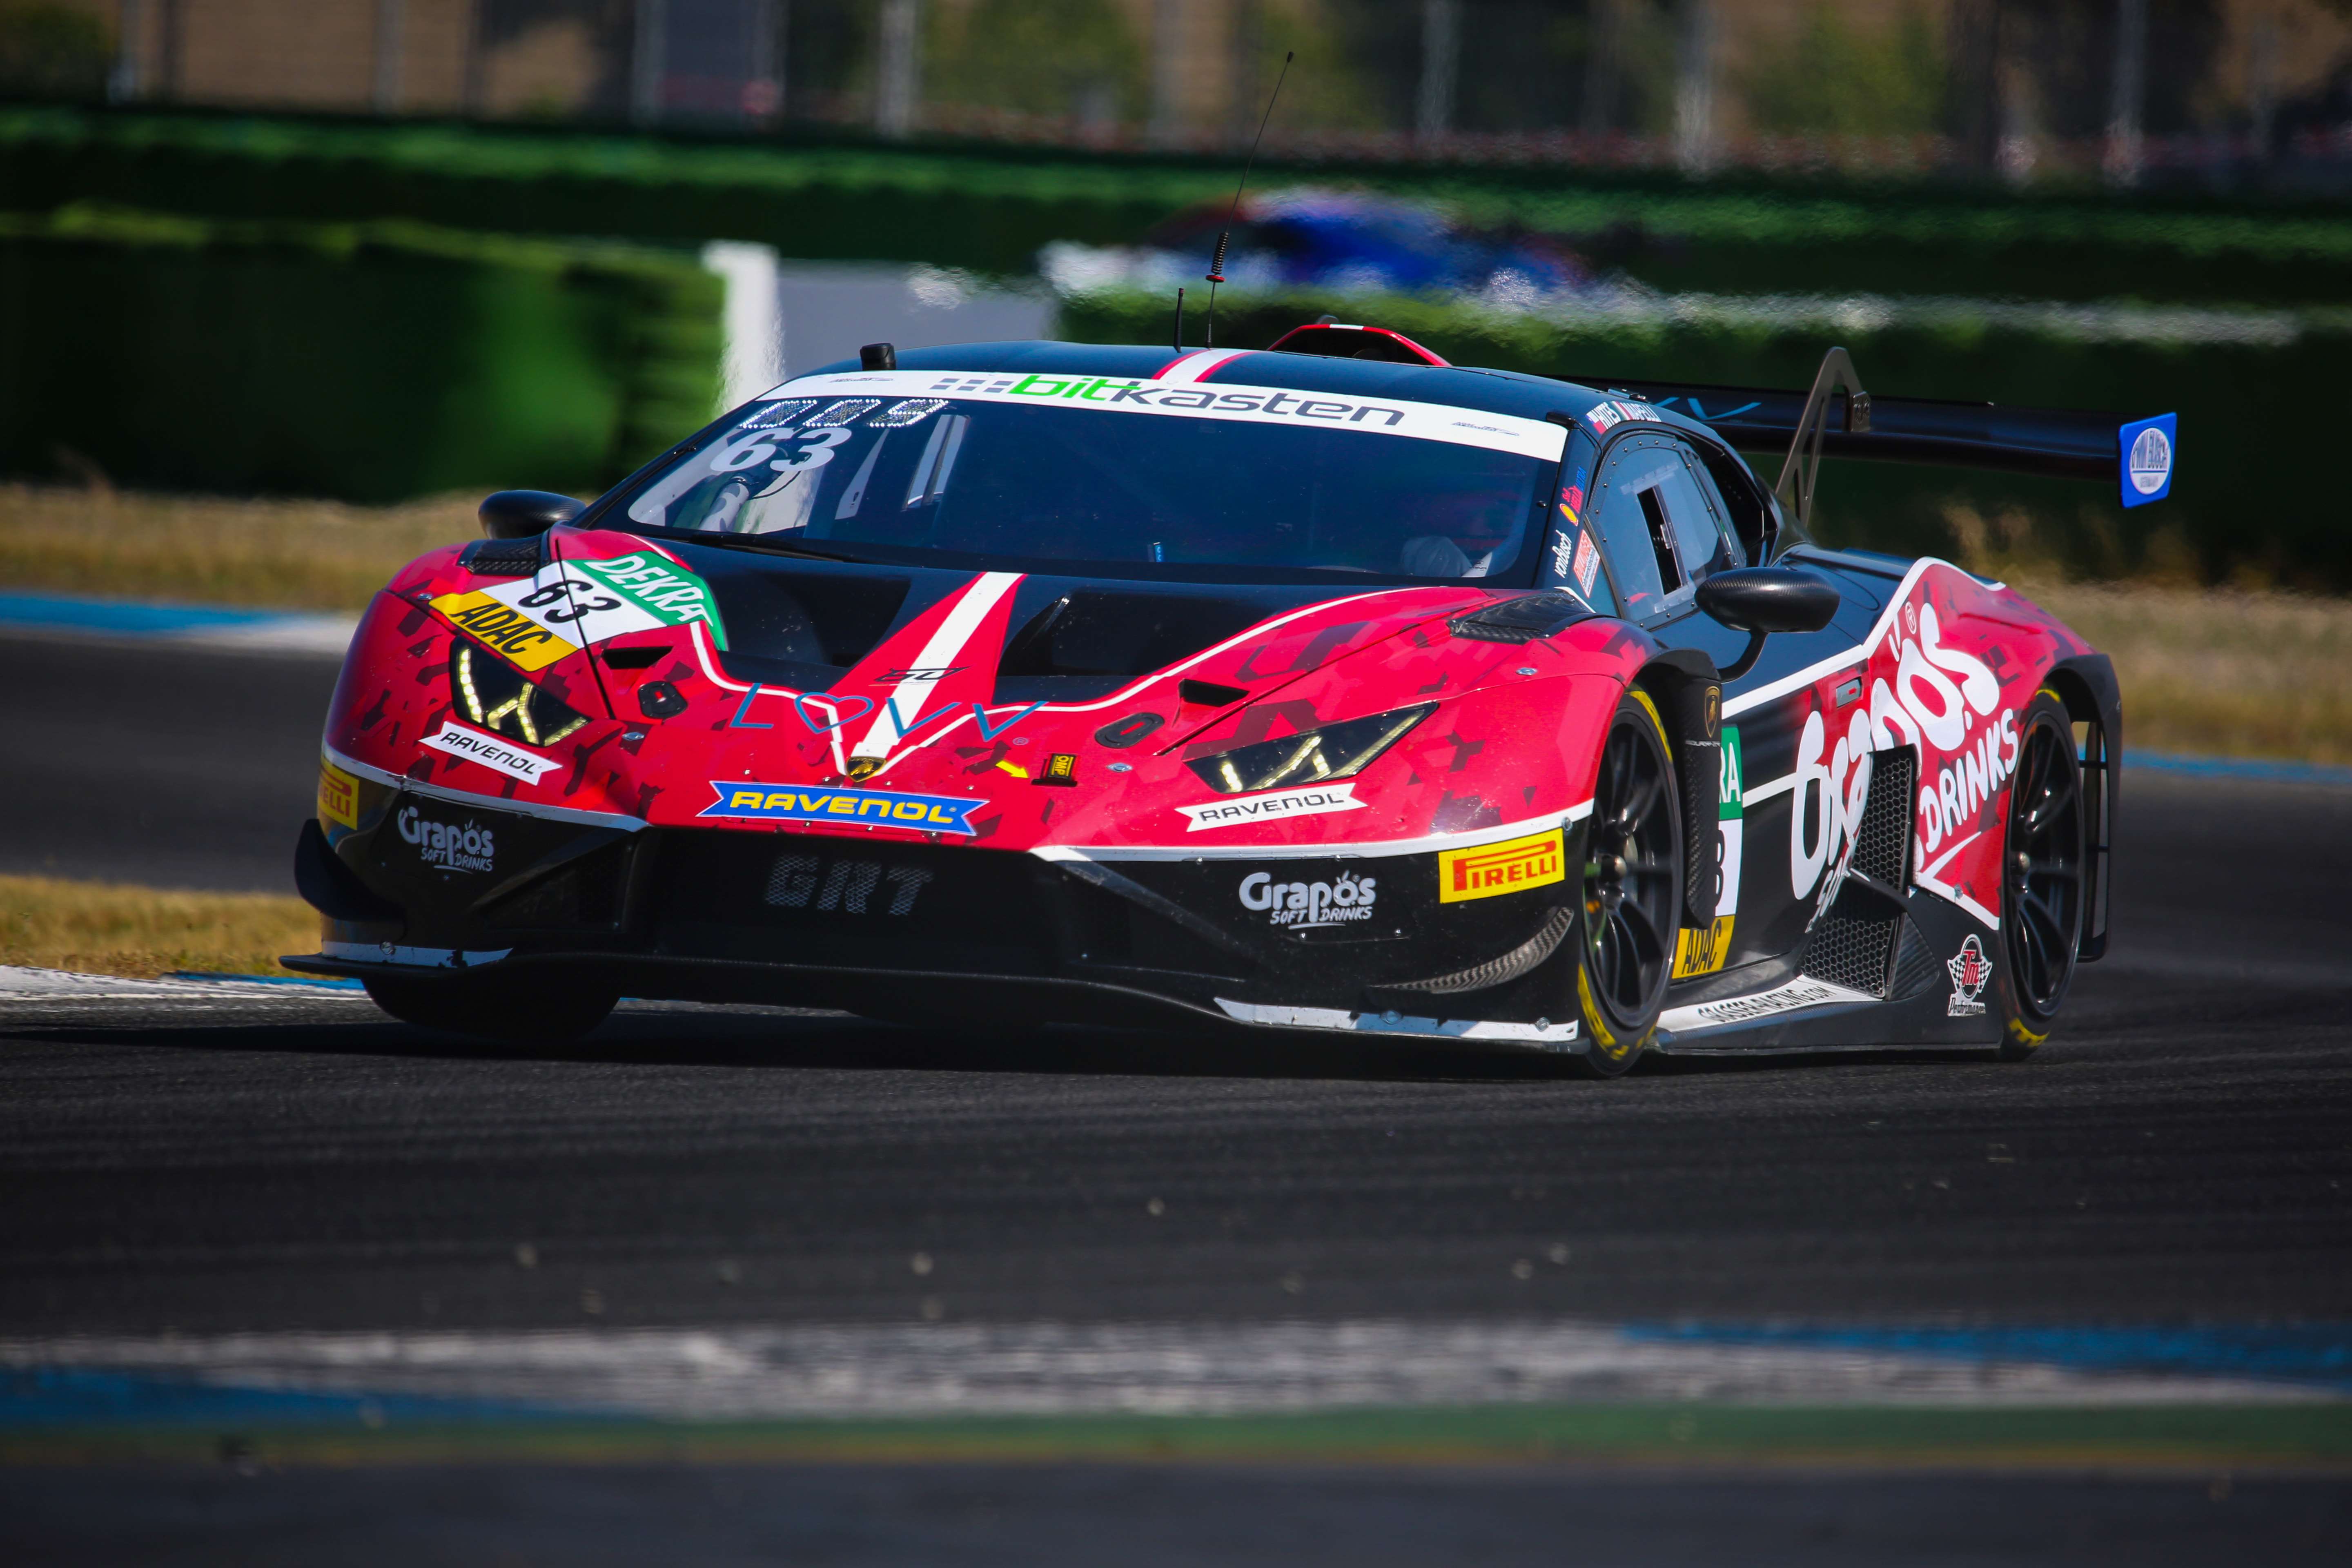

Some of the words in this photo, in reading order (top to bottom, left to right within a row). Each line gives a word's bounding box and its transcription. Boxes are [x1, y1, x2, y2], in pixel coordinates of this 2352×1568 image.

[1007, 374, 1405, 425] bitkasten
[710, 427, 852, 472] 63
[518, 579, 621, 623] 63
[584, 555, 713, 626] DEKRA
[449, 603, 552, 654] ADAC
[440, 731, 537, 775] RAVENOL
[1054, 755, 1069, 776] OMP
[1918, 708, 2019, 853] DRINKS
[729, 791, 956, 824] RAVENOL
[1198, 793, 1345, 822] RAVENOL
[421, 847, 446, 863] SOFT
[454, 853, 493, 872] DRINKS
[1452, 840, 1557, 892] PIRELLI
[764, 854, 935, 915] GRT
[1270, 909, 1308, 925] SOFT
[1319, 906, 1373, 922] DRINKS
[1681, 919, 1722, 975] ADAC
